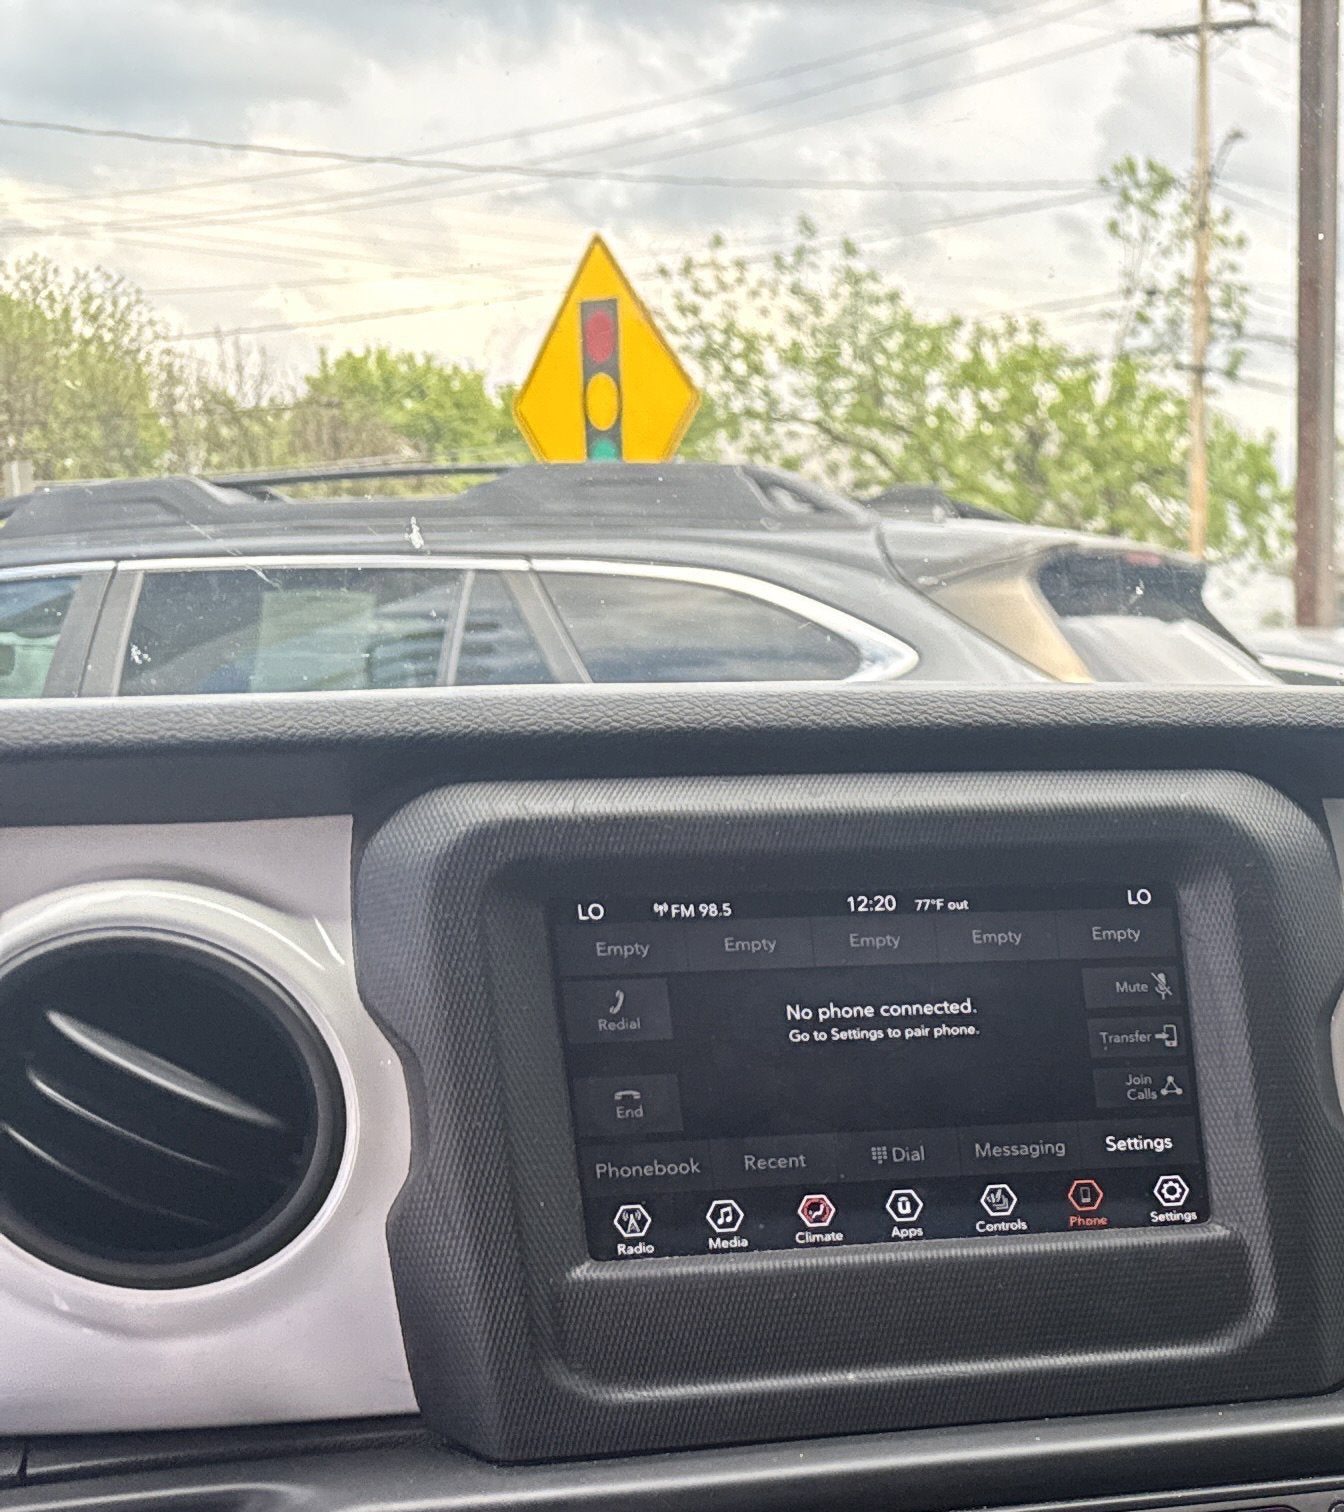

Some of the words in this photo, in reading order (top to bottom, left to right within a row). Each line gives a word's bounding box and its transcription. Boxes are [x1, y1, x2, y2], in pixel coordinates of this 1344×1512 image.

[847, 894, 896, 912] 12:20
[1127, 888, 1151, 905] LO
[577, 903, 604, 921] LO
[671, 903, 695, 918] FM
[698, 902, 732, 917] 98.5
[948, 901, 969, 911] out
[849, 932, 900, 949] Empty
[971, 929, 1022, 945] Empty
[1092, 926, 1140, 942] Empty
[596, 941, 649, 958] Empty
[724, 937, 777, 953] Empty
[1115, 981, 1149, 993] Mute
[786, 1004, 813, 1021] No
[818, 1000, 875, 1023] phone
[880, 997, 977, 1017] connected.
[598, 1018, 641, 1032] Redial
[788, 1029, 809, 1042] Go
[813, 1029, 827, 1041] to
[831, 1026, 884, 1043] Settings
[887, 1027, 901, 1038] to
[904, 1025, 931, 1040] pair
[933, 1023, 980, 1038] phone.
[1100, 1030, 1151, 1044] Transfer
[1126, 1073, 1152, 1086] Join
[1127, 1087, 1157, 1101] Calls
[616, 1106, 644, 1119] End
[975, 1140, 1066, 1161] Messaging
[1105, 1134, 1173, 1152] Settings
[744, 1153, 806, 1171] Recent
[892, 1145, 925, 1163] Dial
[595, 1157, 700, 1179] Phonebook
[1069, 1215, 1108, 1228] Phone
[1150, 1210, 1197, 1225] Settings
[891, 1225, 923, 1240] Apps
[975, 1219, 1028, 1233] Controls
[708, 1236, 749, 1250] Media
[795, 1230, 844, 1244] Climate
[617, 1242, 655, 1256] Radio
